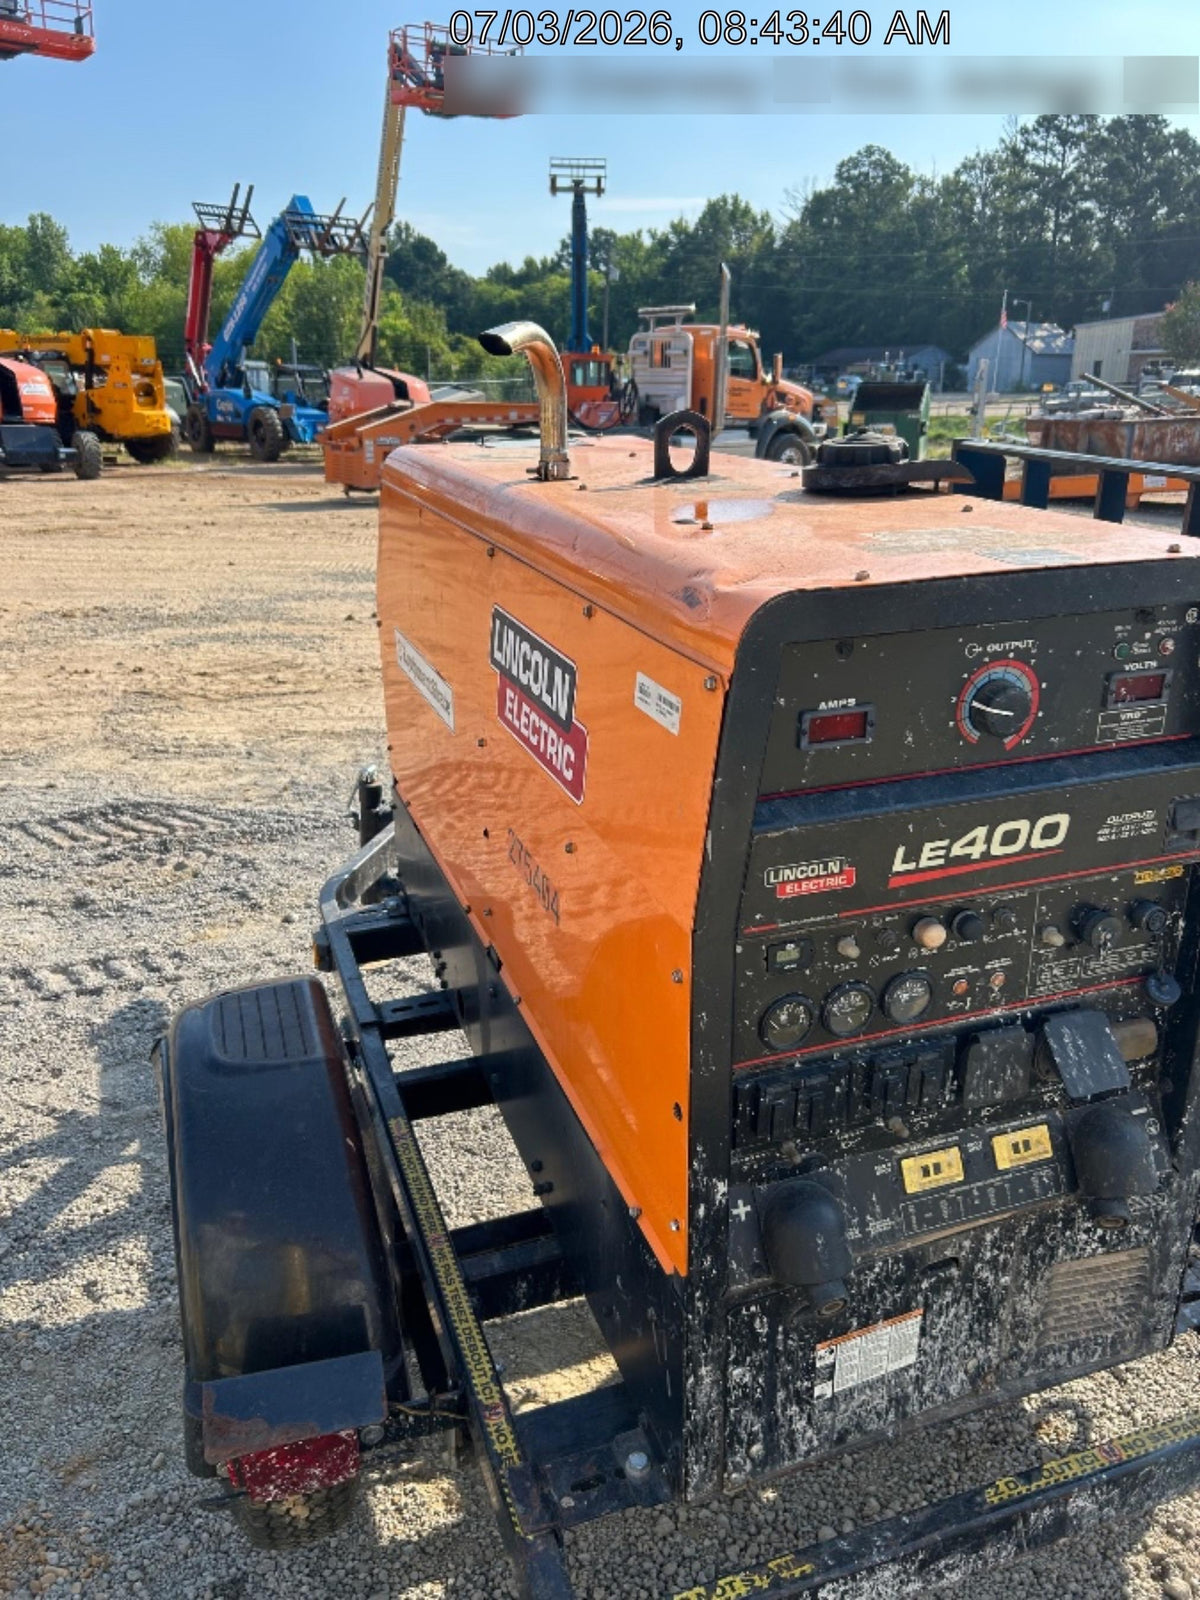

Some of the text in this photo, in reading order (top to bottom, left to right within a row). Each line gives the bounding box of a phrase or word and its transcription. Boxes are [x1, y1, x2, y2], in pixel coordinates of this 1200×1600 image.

[986, 640, 1034, 652] OUTPUT
[493, 618, 571, 721] LINCOLN
[818, 698, 856, 710] AMPS
[504, 687, 576, 782] ELECTRIC
[892, 813, 1070, 873] LE400
[769, 860, 841, 883] LINCOLN
[785, 875, 847, 893] ELECTRIC
[462, 1327, 488, 1379] DEBOUT
[480, 1382, 494, 1400] ICI
[492, 1422, 508, 1444] NO
[1121, 1438, 1146, 1453] NO
[1152, 1429, 1171, 1443] SE
[1076, 1453, 1100, 1467] ICI
